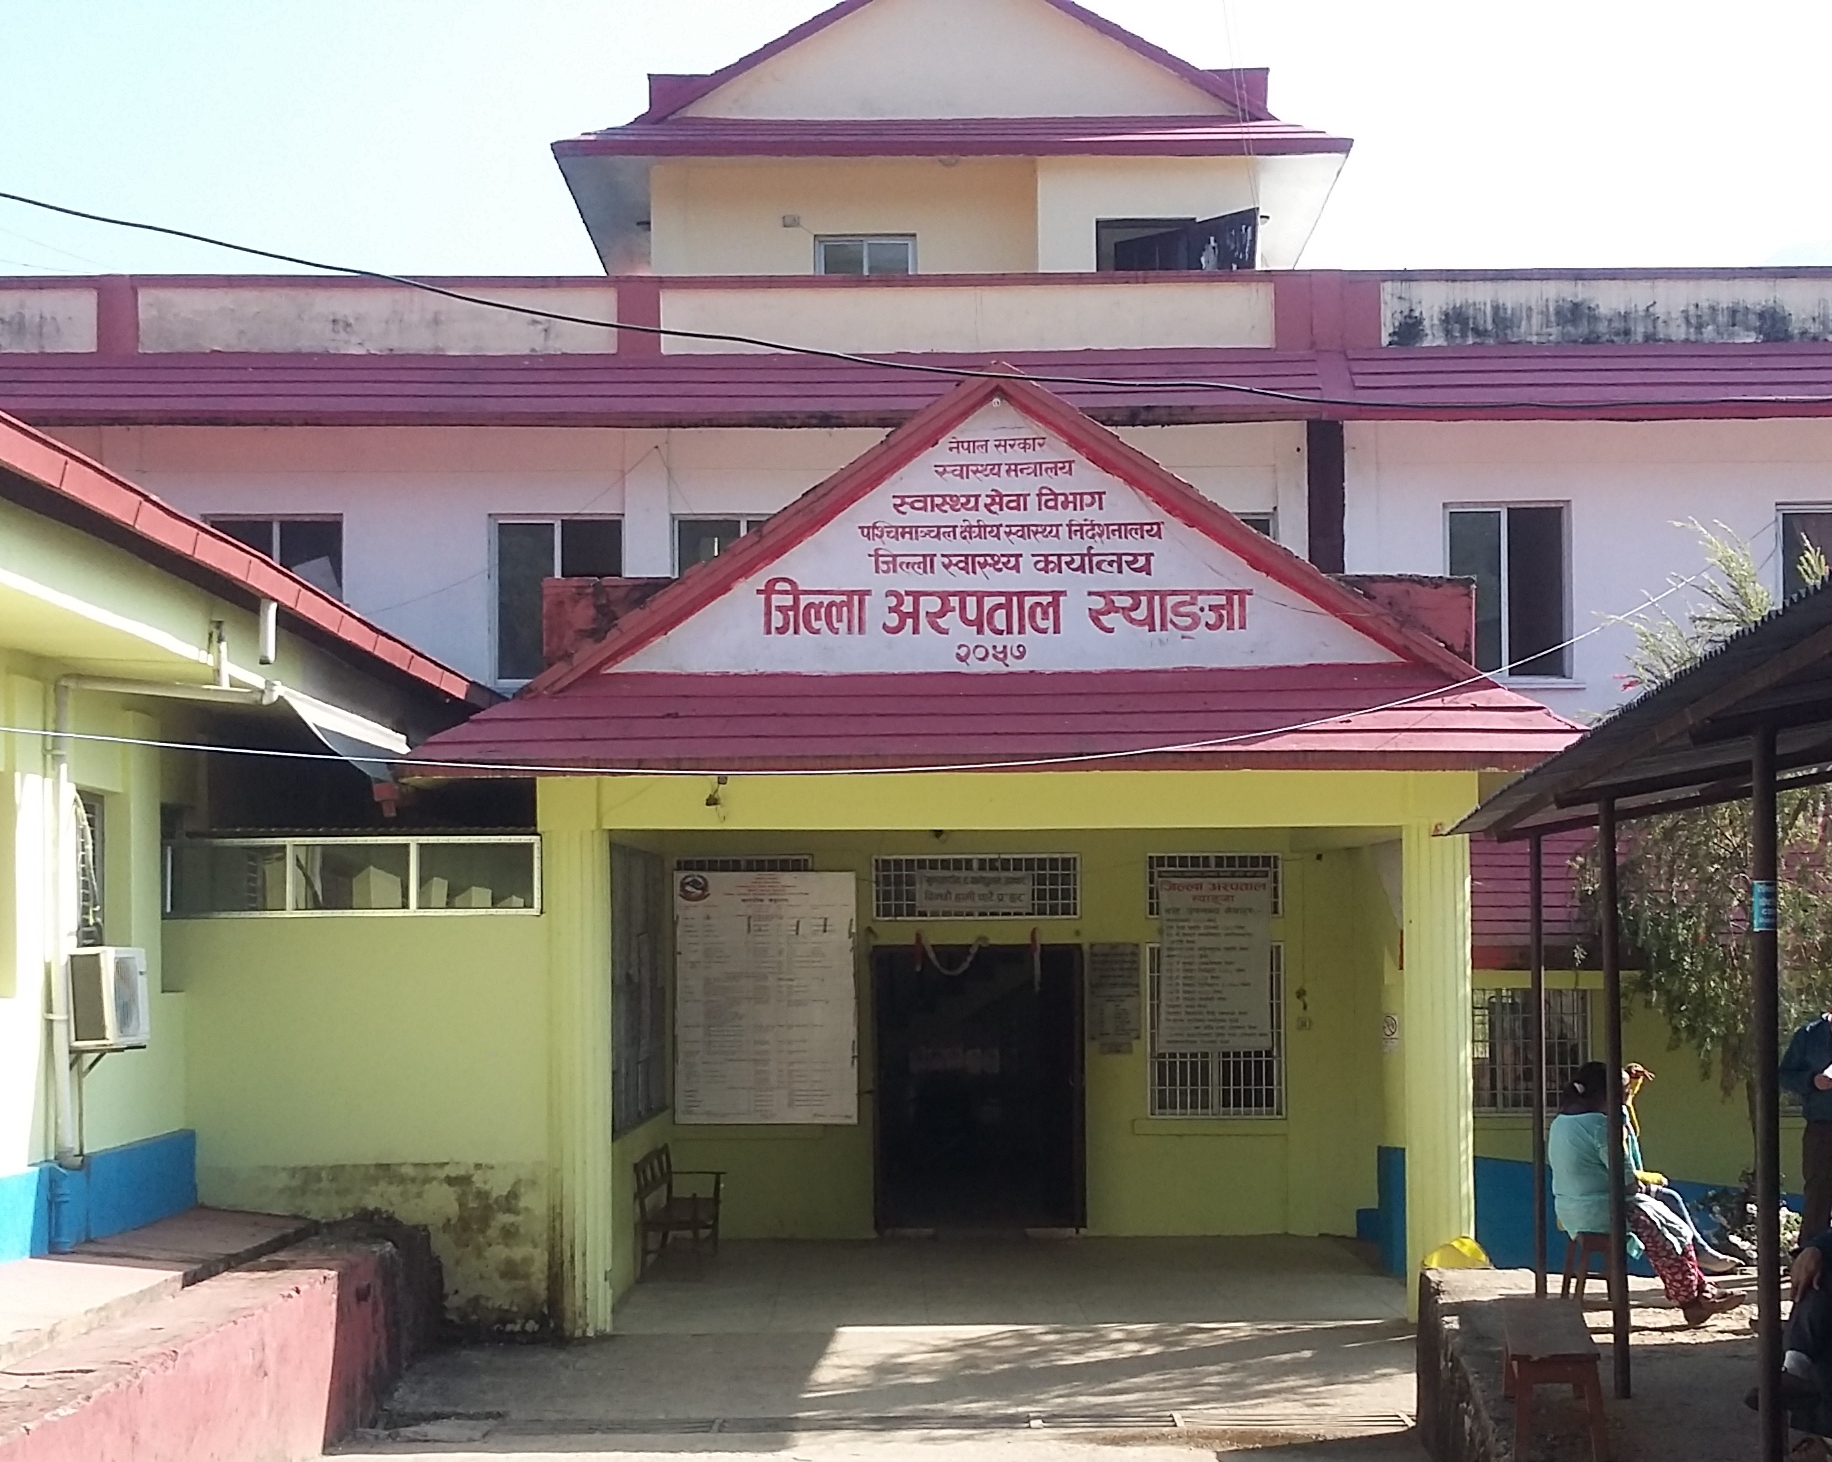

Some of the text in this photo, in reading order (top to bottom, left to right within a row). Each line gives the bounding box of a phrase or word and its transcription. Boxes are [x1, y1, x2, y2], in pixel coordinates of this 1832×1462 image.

[948, 436, 1047, 454] नेपाल सरकार
[933, 459, 1075, 481] स्वास्थ्य मन्त्रालय
[892, 487, 1107, 516] स्वास्थ्य सेवा विभाग
[858, 518, 1165, 545] पश्चिमाञ्चल क्षेत्रीय स्वास्थ्य निर्देशनालय
[868, 545, 1155, 580] जिल्ला स्वास्थ्य कार्यालय
[756, 576, 1254, 640] जिल्ला अस्पताल स्याङ्जा
[955, 643, 1027, 668] २०५७
